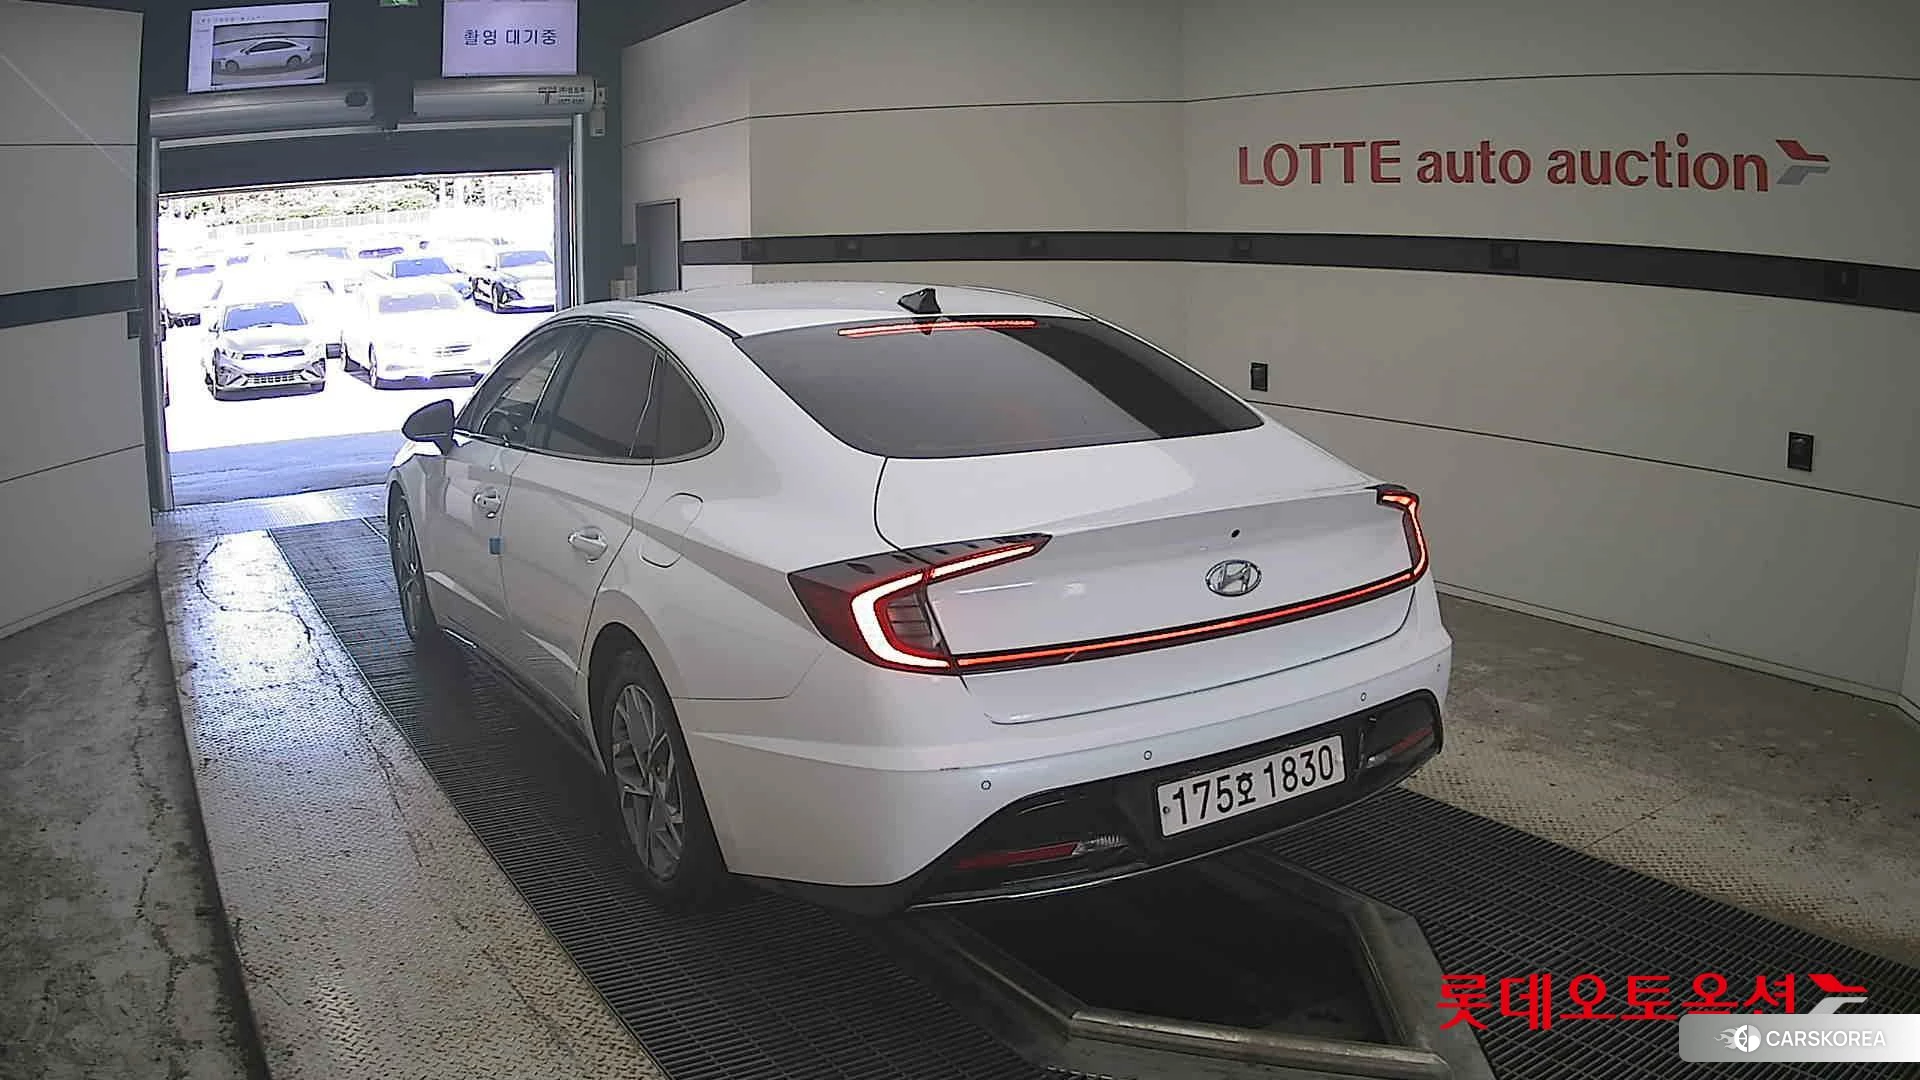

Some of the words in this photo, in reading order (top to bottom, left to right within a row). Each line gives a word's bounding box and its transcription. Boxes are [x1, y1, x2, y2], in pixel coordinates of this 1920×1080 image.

[464, 28, 497, 46] 촬영
[505, 28, 557, 46] 대기중
[1238, 139, 1402, 187] LOTTE
[1416, 139, 1532, 186] auto
[1546, 133, 1769, 192] auction
[1172, 772, 1256, 825] 175호
[1263, 745, 1334, 798] 1830
